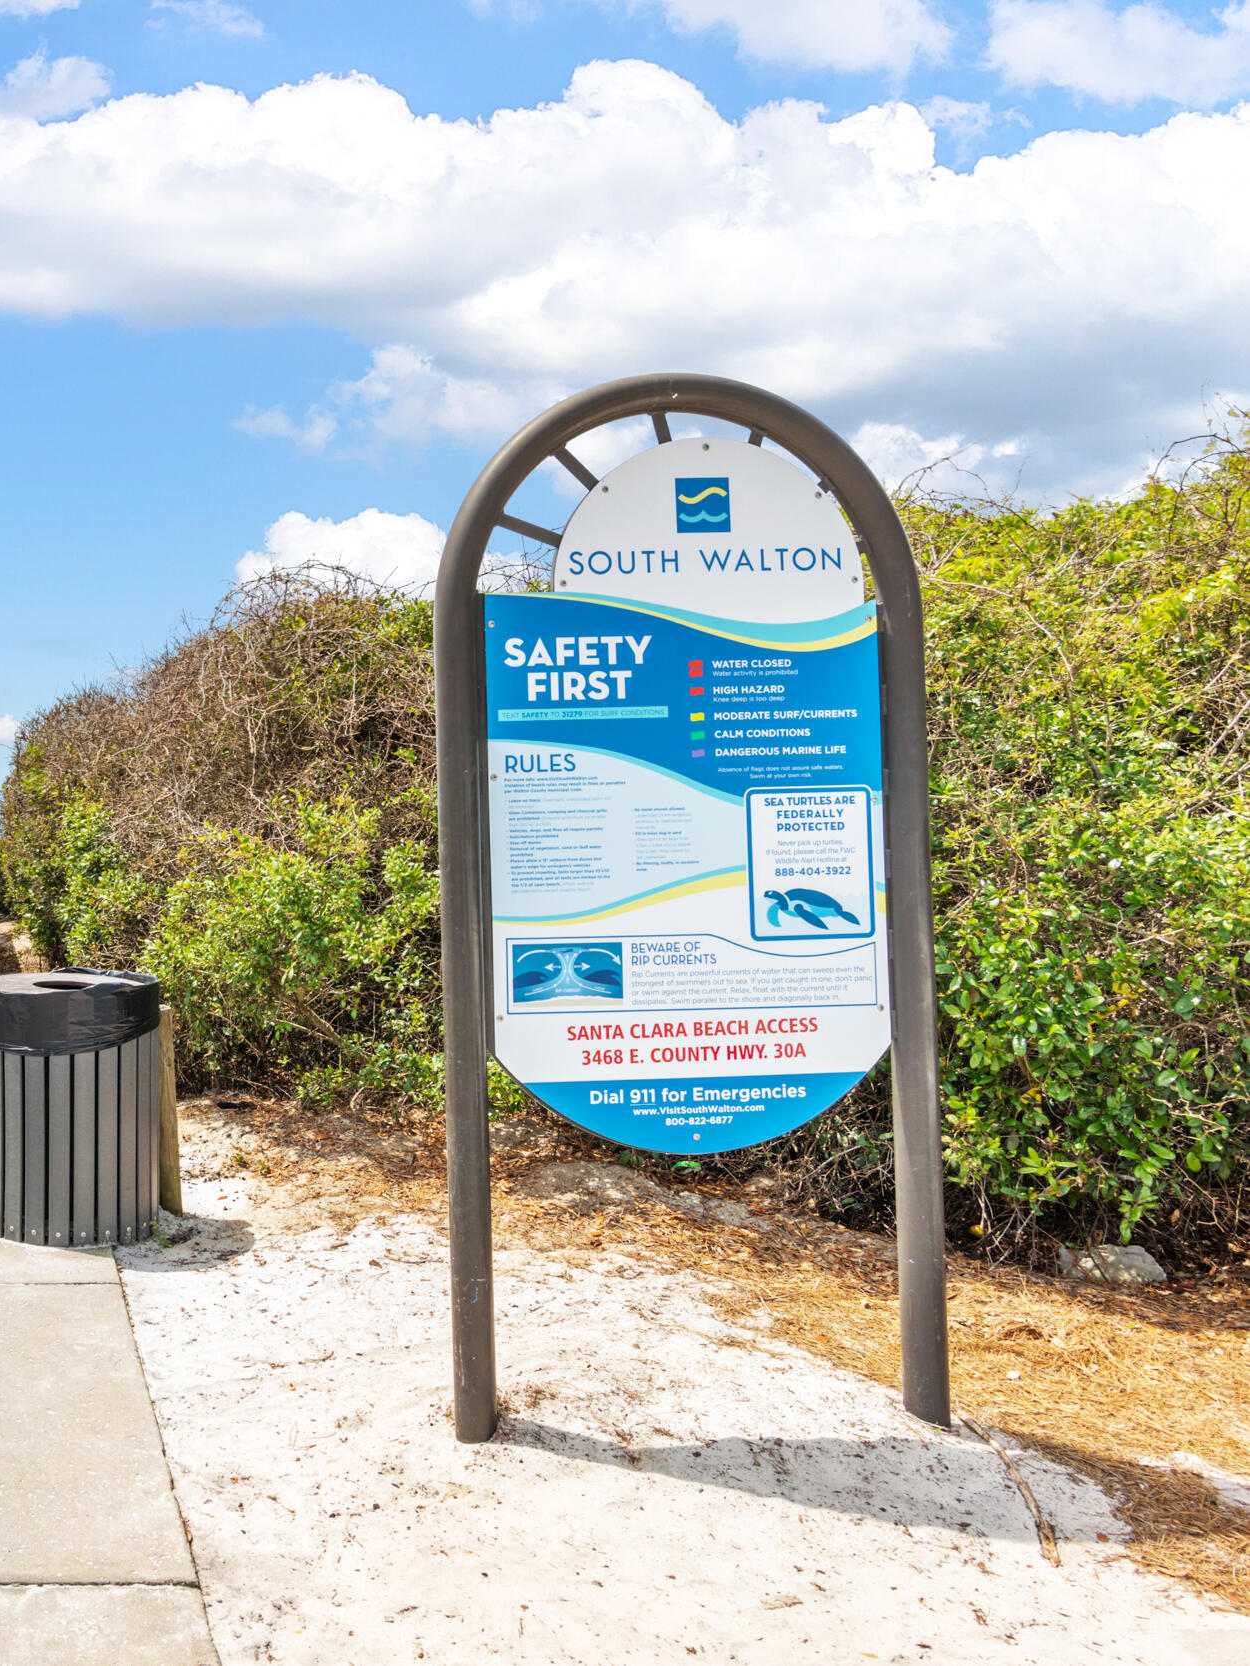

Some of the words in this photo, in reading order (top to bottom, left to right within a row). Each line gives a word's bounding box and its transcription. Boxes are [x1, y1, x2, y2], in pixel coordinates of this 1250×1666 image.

[569, 550, 679, 575] SOUTH
[699, 547, 842, 572] WALTON
[504, 635, 651, 667] SAFETY
[712, 660, 748, 668] WATER
[751, 659, 791, 667] CLOSED
[527, 670, 632, 701] FIRST
[713, 686, 738, 694] HIGH
[741, 685, 784, 693] HAZARD
[562, 711, 582, 719] 31279
[714, 711, 770, 720] MODERATE
[774, 709, 857, 719] SURF/CURRENTS
[715, 730, 743, 738] CALM
[746, 729, 810, 737] CONDITIONS
[715, 747, 779, 756] DANGEROUS
[783, 746, 822, 754] MARINE
[825, 745, 846, 754] LIFE
[505, 753, 576, 774] RULES
[764, 798, 784, 806] SEA
[787, 796, 831, 805] TURTLES
[834, 796, 855, 804] ARE
[777, 809, 843, 819] FEDERALLY
[777, 822, 844, 831] PROTECTED
[775, 867, 850, 876] 888-404-3922
[631, 942, 680, 953] BEWARE
[684, 942, 700, 952] OF
[632, 955, 650, 966] RIP
[653, 954, 716, 965] CURRENTS
[568, 1025, 624, 1040] SANTA
[630, 1023, 687, 1038] CLARA
[694, 1021, 748, 1036] BEACH
[755, 1018, 817, 1034] ACCESS
[583, 1050, 623, 1065] 3468
[630, 1049, 643, 1063] E.
[651, 1046, 720, 1062] COUNTY
[727, 1045, 767, 1060] HWY.
[774, 1043, 806, 1058] 30A
[590, 1090, 624, 1104] Dial
[630, 1089, 655, 1105] 911
[662, 1088, 687, 1102] for
[693, 1085, 805, 1101] Emergencies
[634, 1105, 764, 1115] www.VisitSouthWalton.com
[666, 1116, 733, 1125] 800-822-6877
